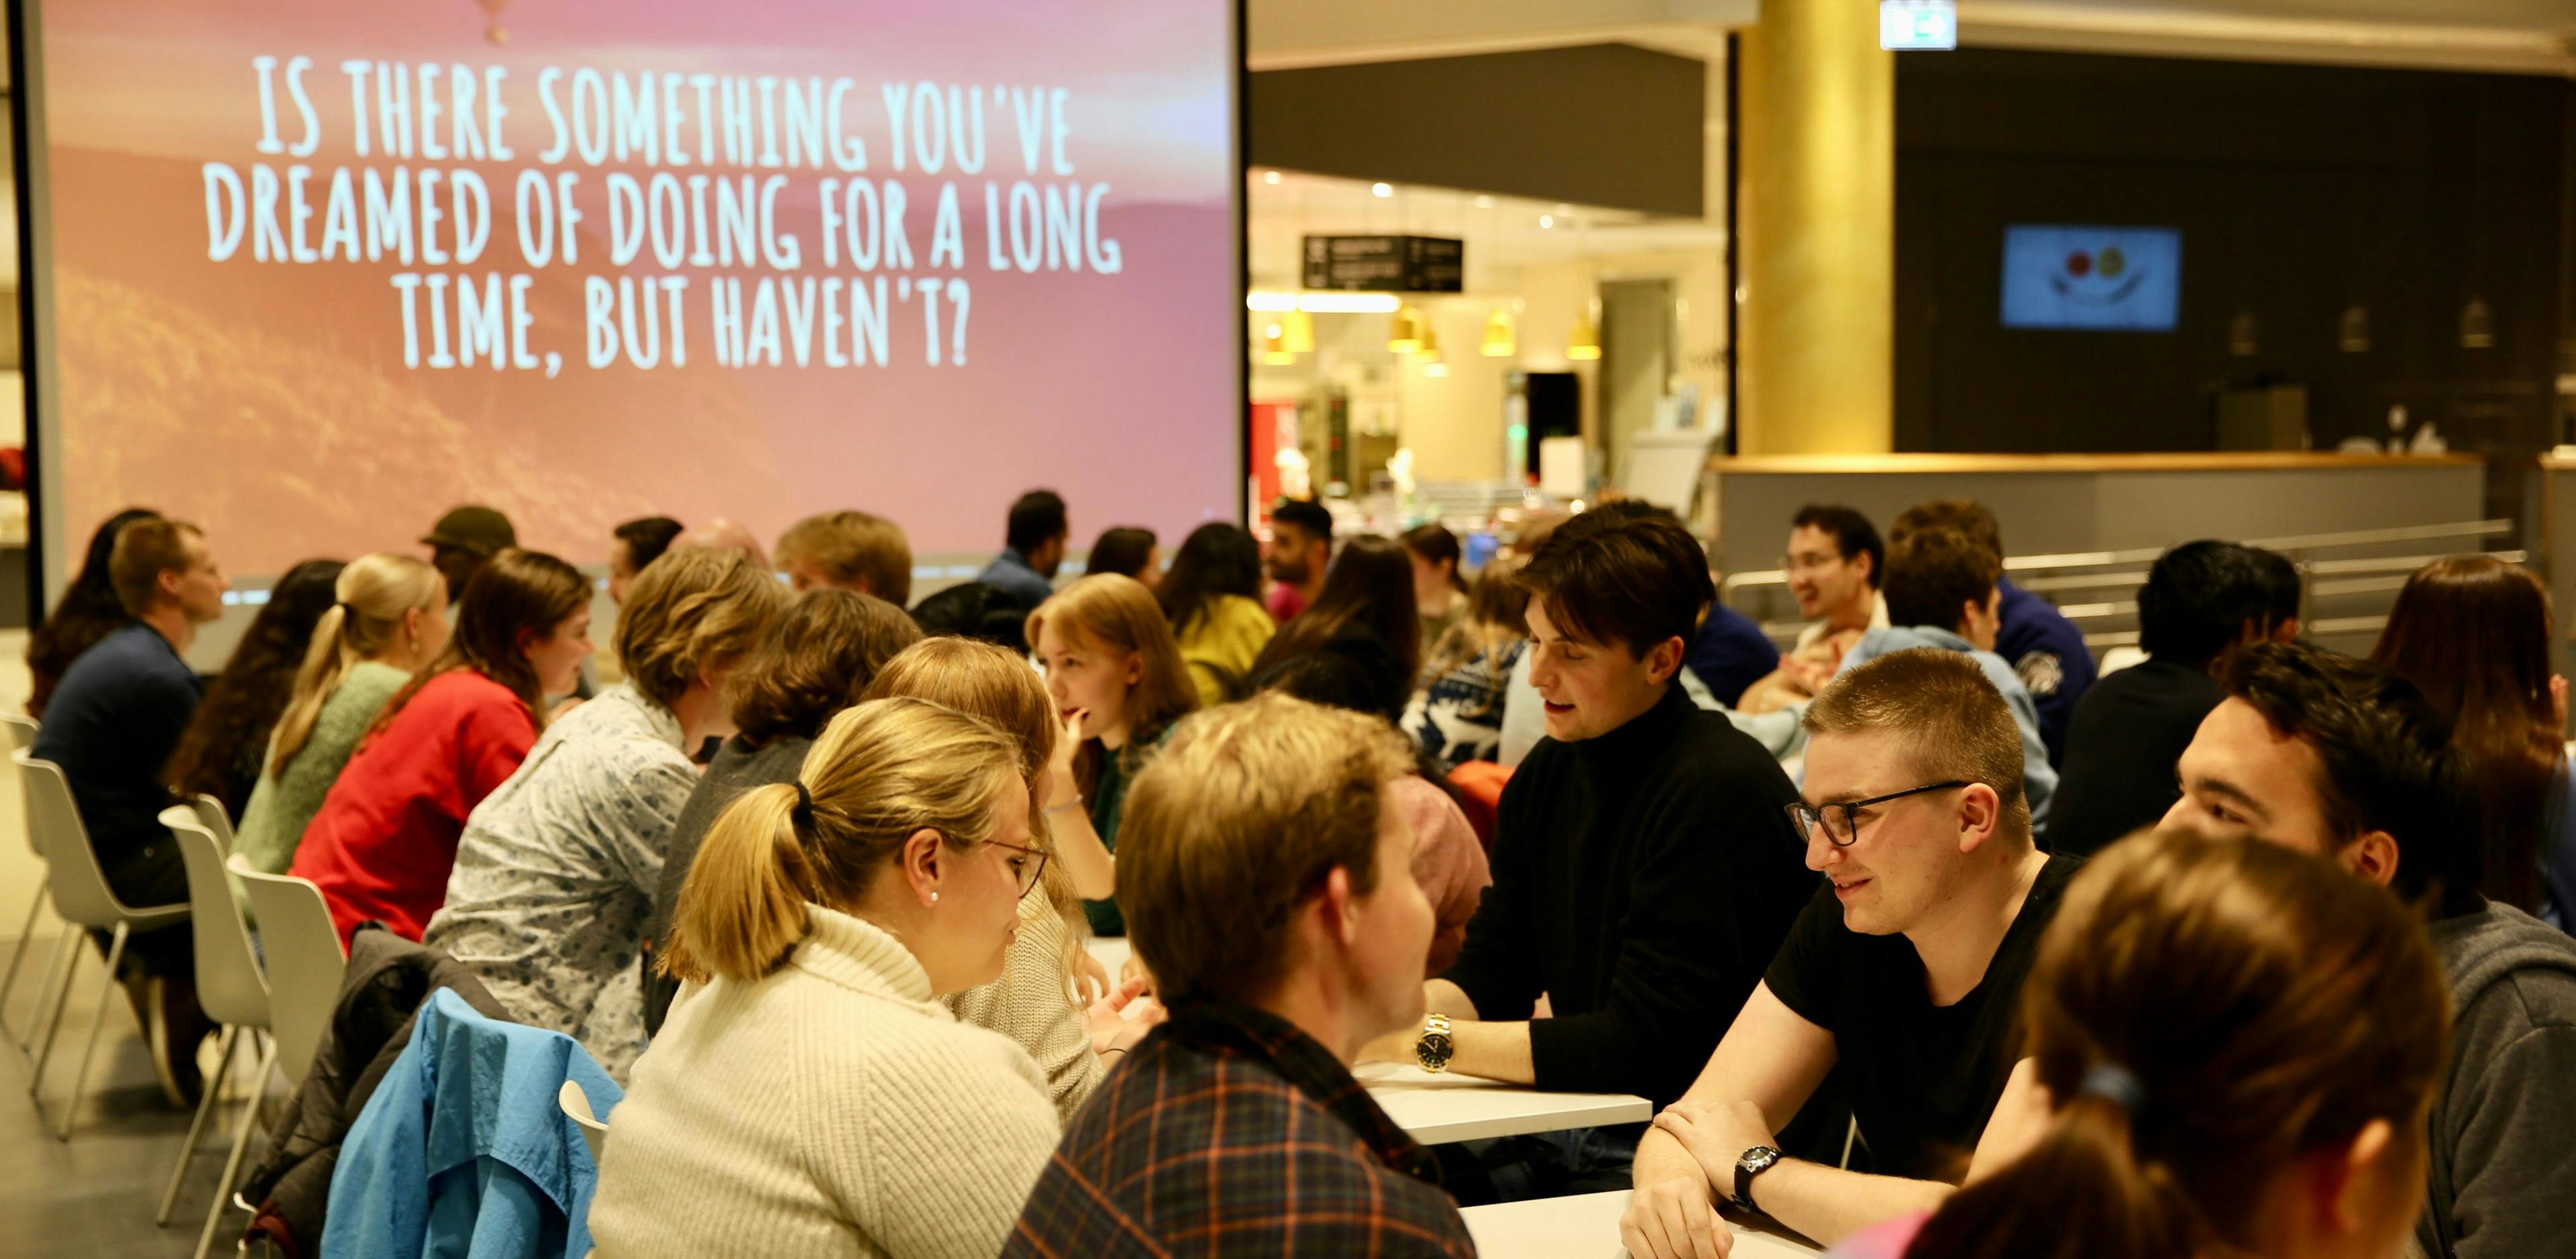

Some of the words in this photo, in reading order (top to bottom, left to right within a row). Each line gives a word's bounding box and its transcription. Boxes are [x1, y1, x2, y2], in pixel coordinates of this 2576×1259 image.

[252, 55, 320, 157] IS
[341, 59, 515, 161] THERE
[536, 64, 867, 172] SOMETHING
[881, 79, 1076, 176] YOU'VE
[203, 162, 490, 264] DREAMED
[516, 169, 582, 268] OF
[606, 172, 801, 271] DOING
[819, 178, 914, 272] FOR
[929, 182, 964, 269] A
[984, 179, 1122, 274] LONG
[391, 273, 561, 377] TIME,
[586, 275, 688, 369] BUT
[711, 276, 971, 368] HAVEN'T?
